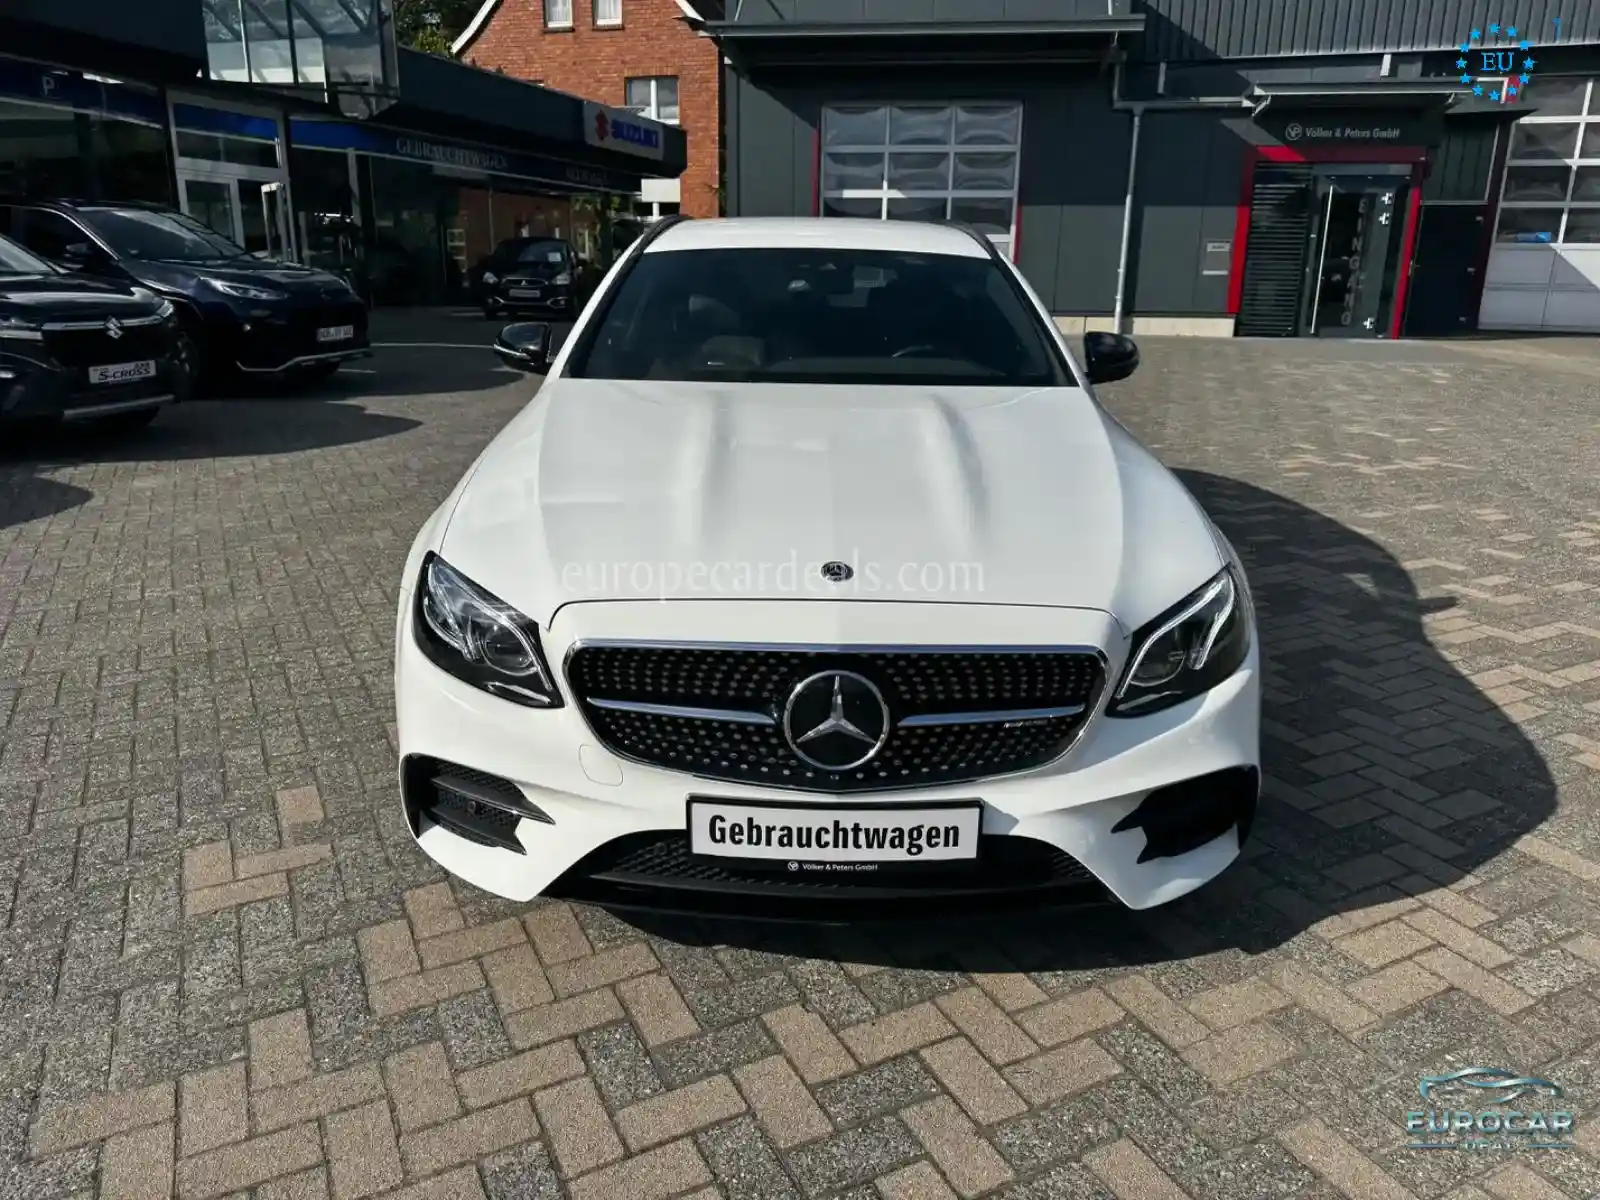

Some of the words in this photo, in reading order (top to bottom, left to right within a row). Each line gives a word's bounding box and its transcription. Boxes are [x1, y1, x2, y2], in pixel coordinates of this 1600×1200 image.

[1334, 126, 1342, 138] &
[1344, 127, 1371, 139] Peters
[1372, 127, 1401, 139] GmbH
[1340, 197, 1368, 326] EINGANG
[98, 367, 151, 382] S-CROSS
[708, 814, 960, 856] Gebrauchtwagen
[801, 862, 825, 871] Völker
[825, 863, 831, 871] &
[832, 862, 854, 872] Peters
[855, 863, 878, 872] GmbH
